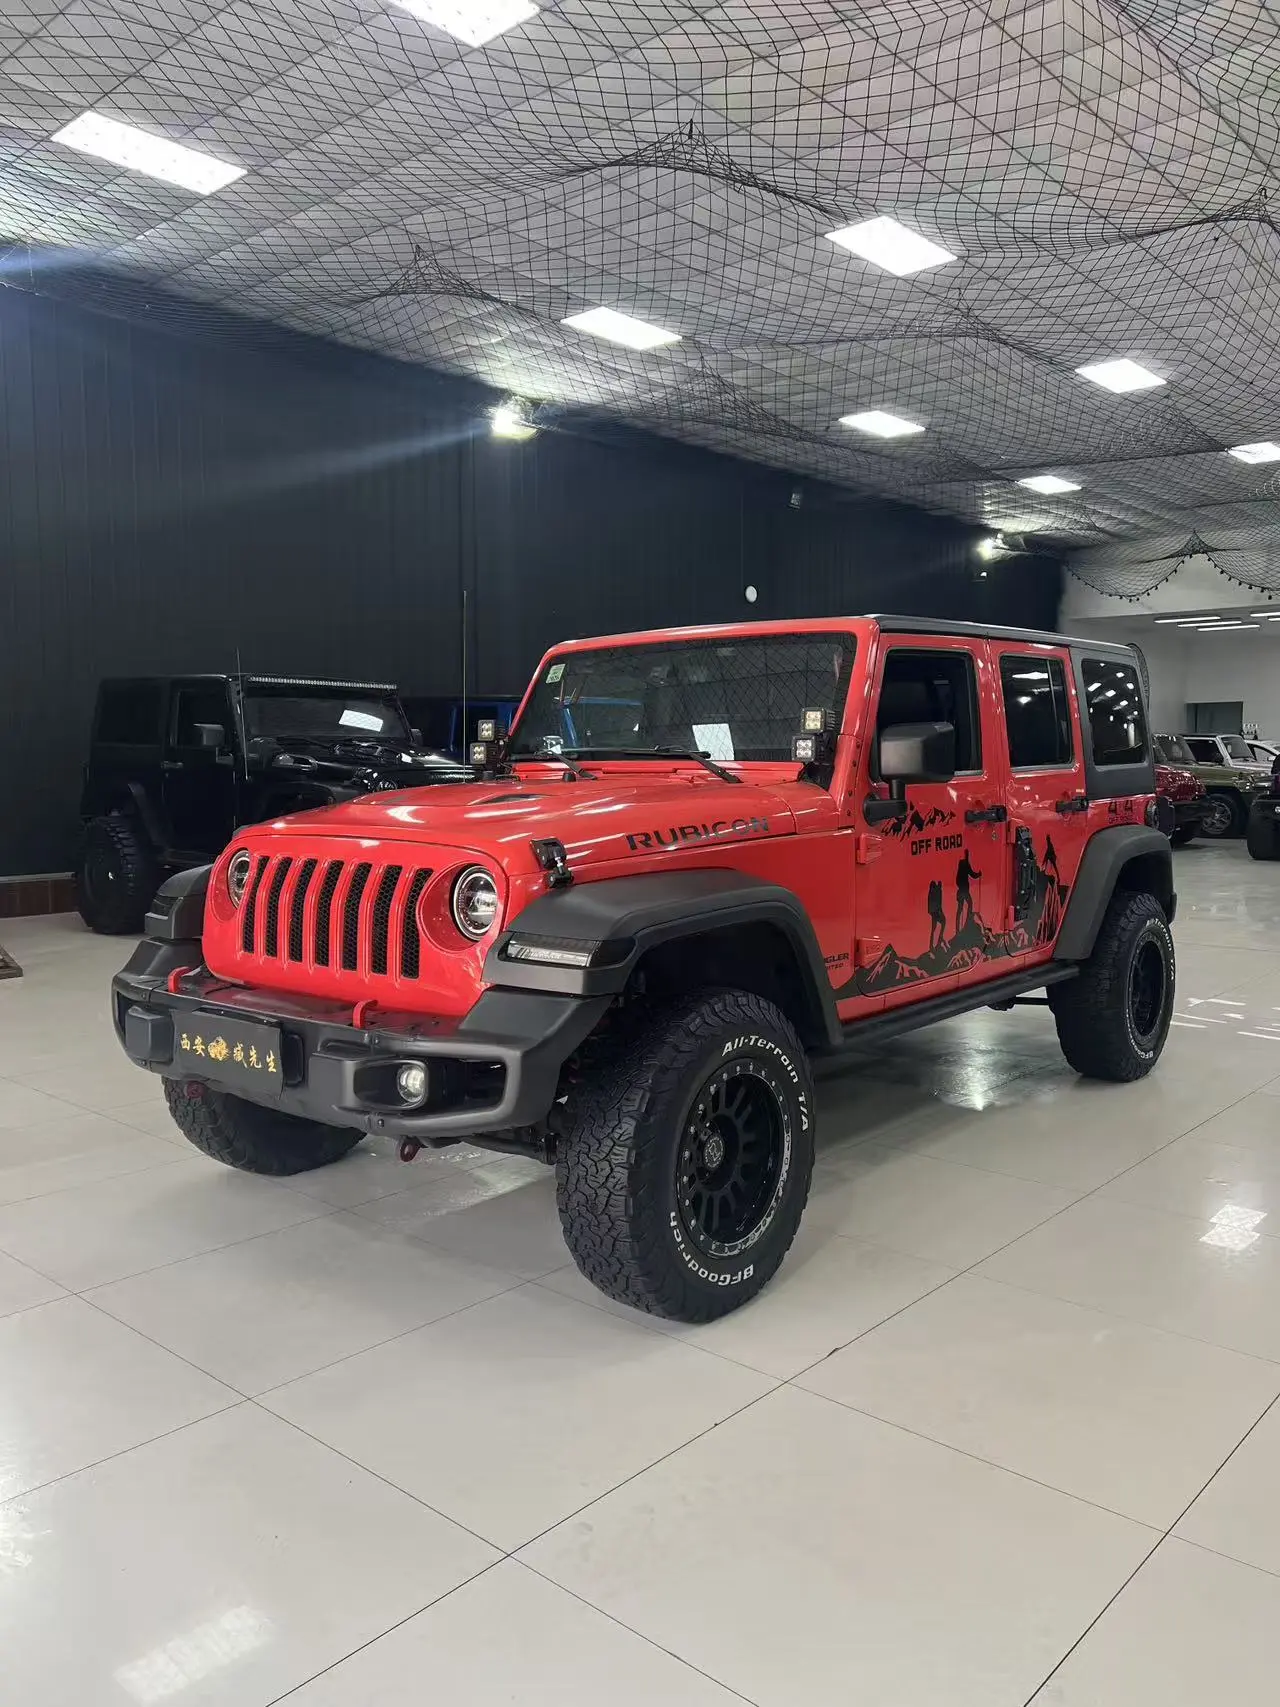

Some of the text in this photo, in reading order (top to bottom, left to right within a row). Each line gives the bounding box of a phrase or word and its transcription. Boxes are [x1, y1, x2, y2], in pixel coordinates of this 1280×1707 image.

[626, 816, 769, 850] RUBICON
[911, 833, 963, 855] OFF ROAD
[722, 1035, 809, 1131] All-Terrain T/A
[670, 1211, 754, 1286] BFGoodrich
